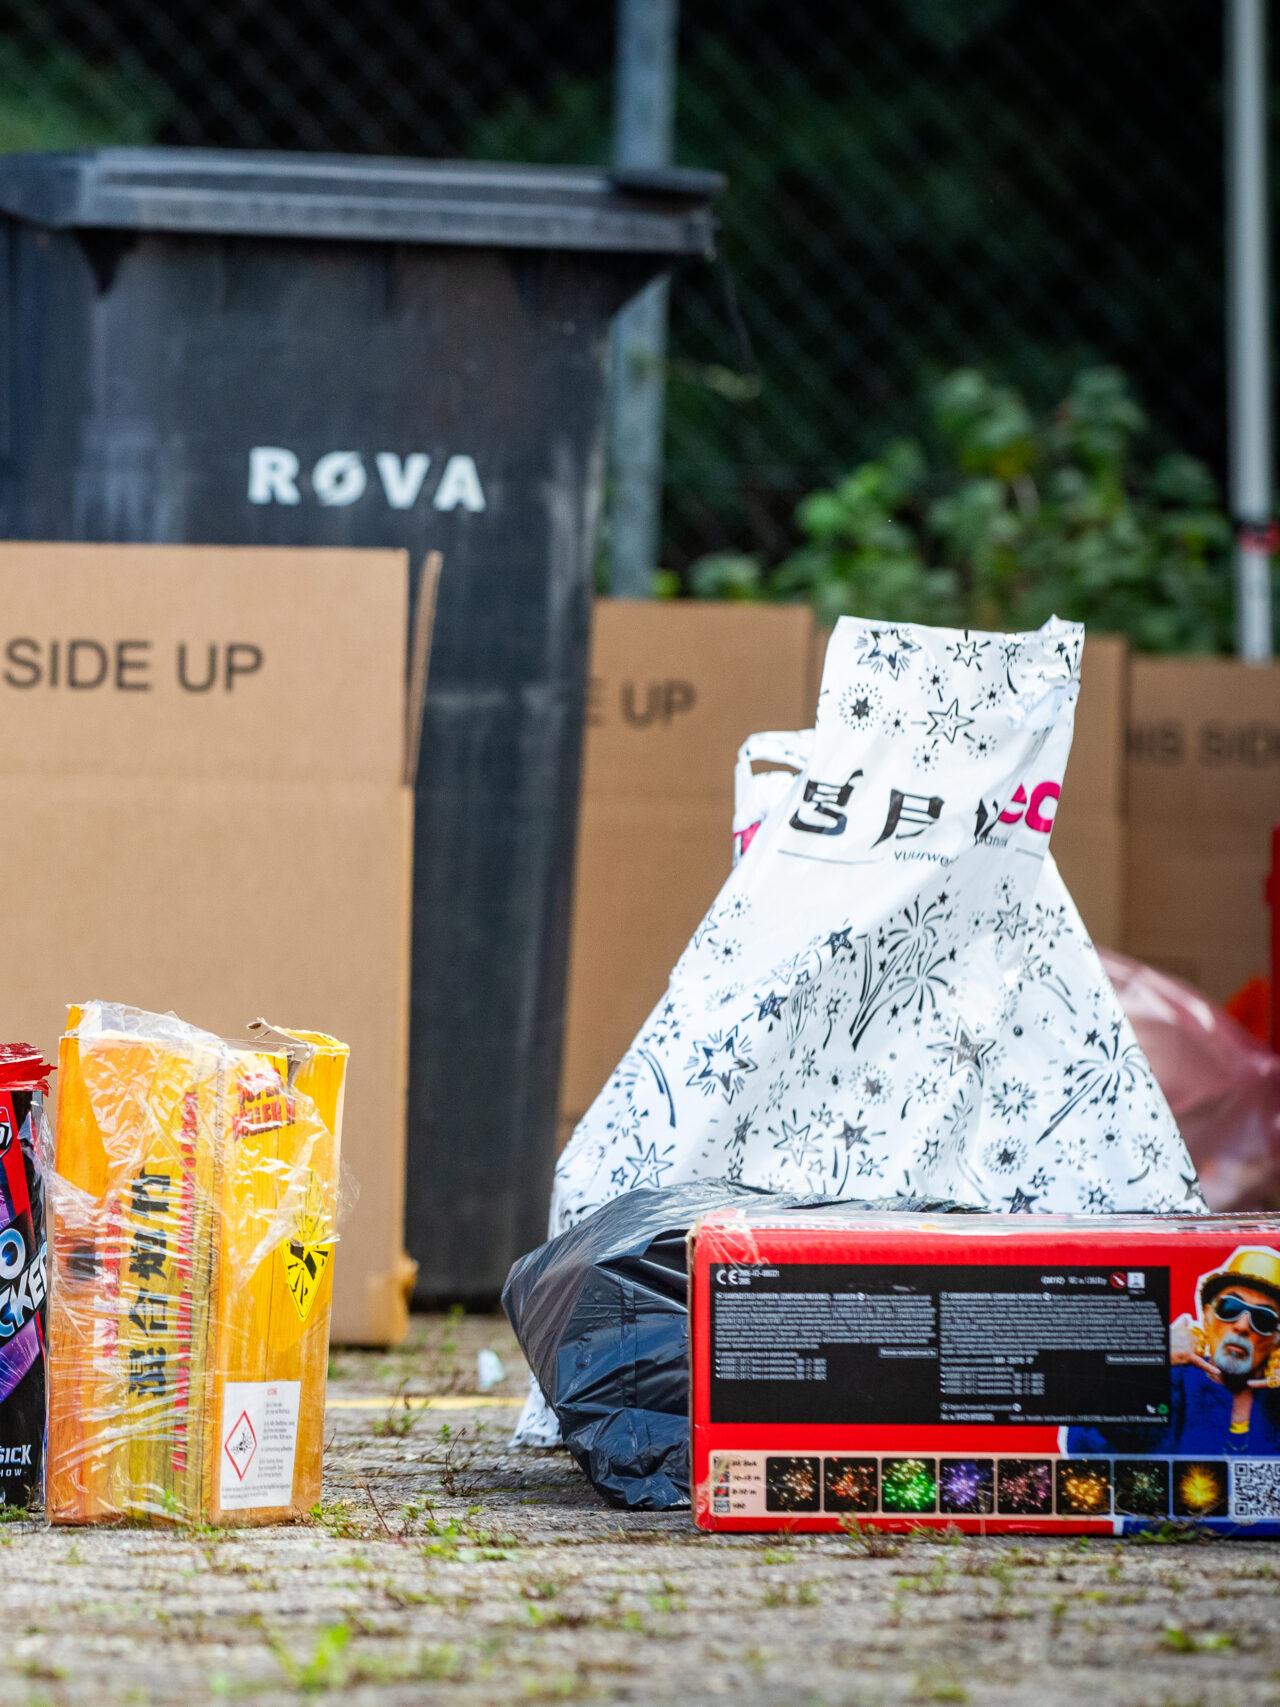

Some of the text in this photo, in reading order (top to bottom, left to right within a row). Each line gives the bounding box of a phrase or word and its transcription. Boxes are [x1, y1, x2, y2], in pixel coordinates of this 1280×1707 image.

[247, 446, 487, 512] RØVA
[4, 636, 151, 691] SIDE
[176, 641, 264, 692] UP
[622, 678, 697, 729] UP
